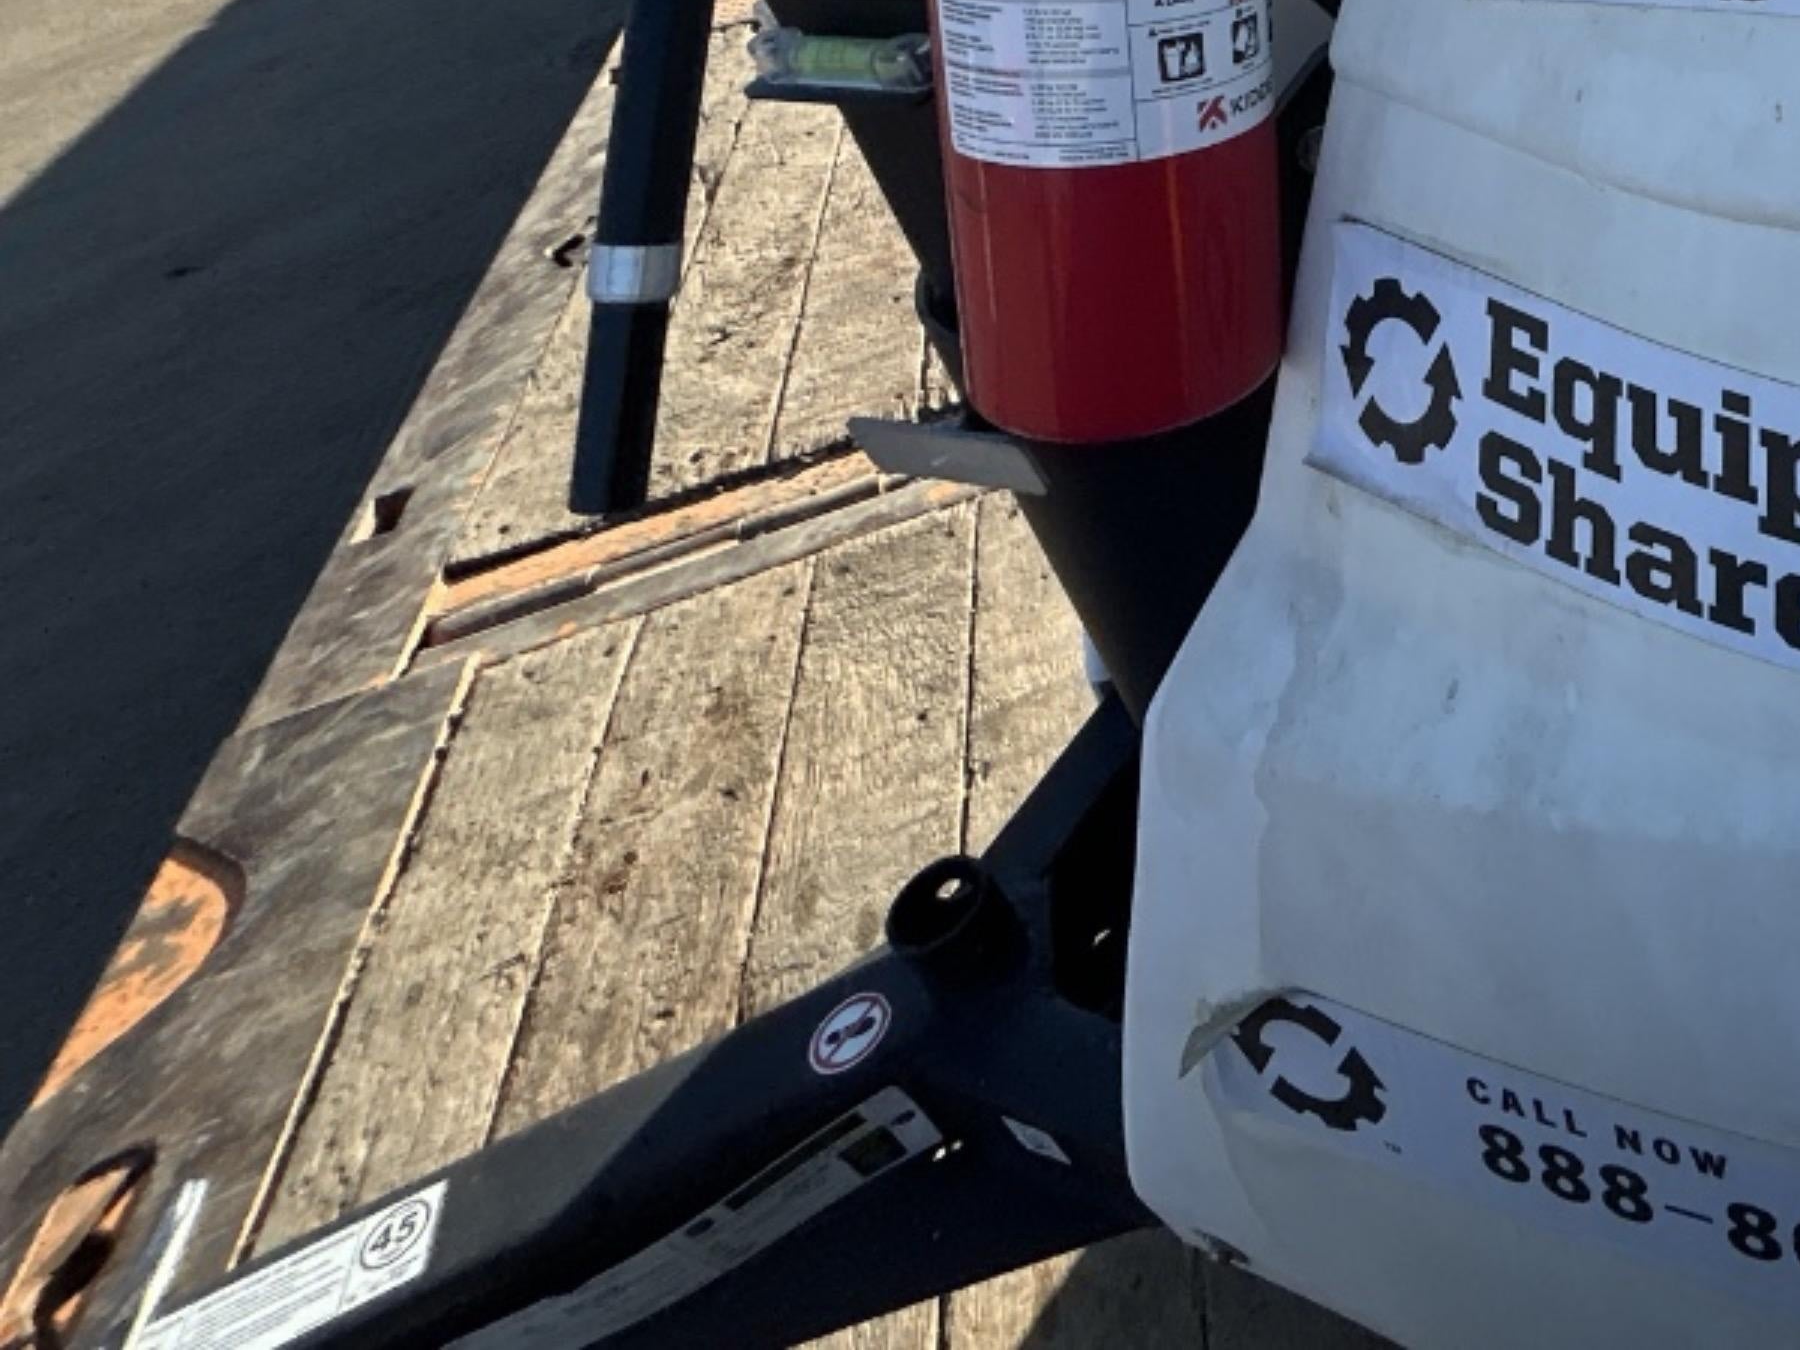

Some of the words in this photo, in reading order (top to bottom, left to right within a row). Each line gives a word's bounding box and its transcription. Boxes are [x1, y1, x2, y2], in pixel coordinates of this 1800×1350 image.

[1466, 1077, 1587, 1138] CALL
[1614, 1124, 1727, 1179] NOW
[367, 1211, 418, 1253] 45
